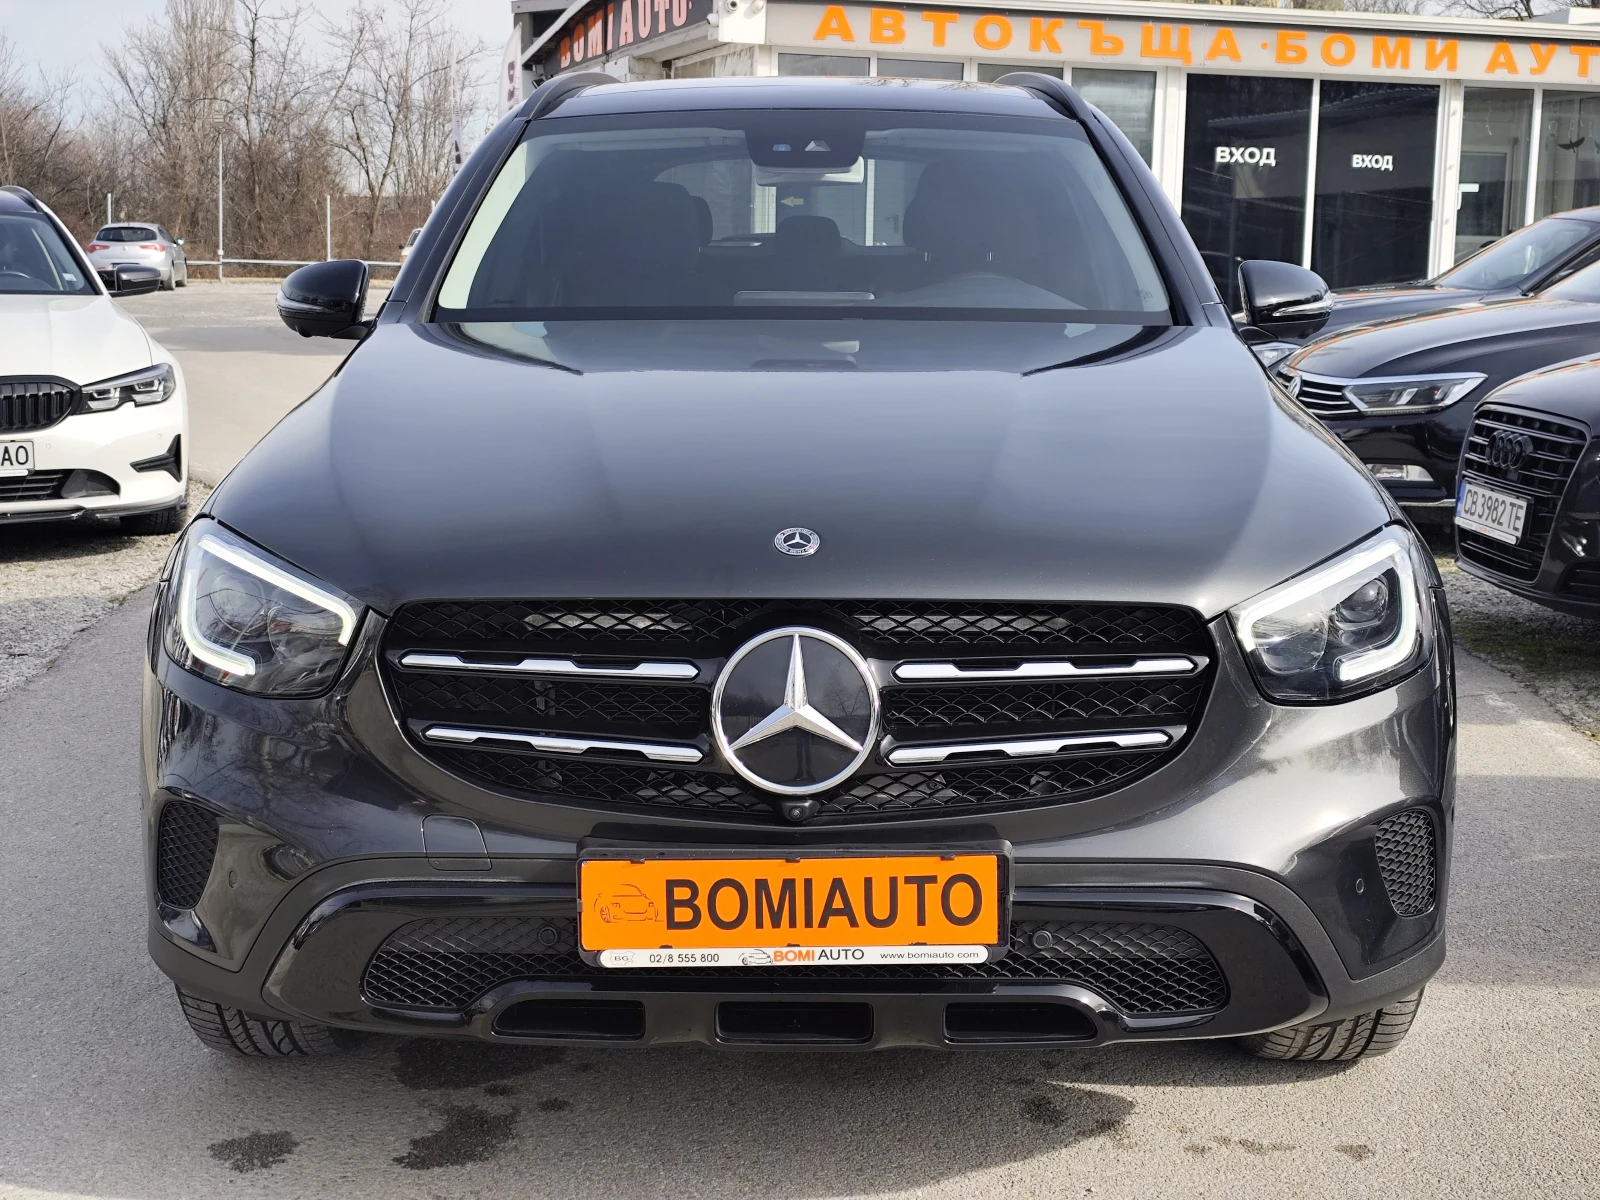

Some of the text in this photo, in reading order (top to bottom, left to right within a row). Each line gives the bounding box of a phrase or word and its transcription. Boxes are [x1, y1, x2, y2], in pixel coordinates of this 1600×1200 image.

[813, 5, 1242, 66] АВТОКЪЩА
[1215, 146, 1276, 166] ВХОД
[1352, 154, 1393, 171] ВХОД
[665, 874, 982, 930] BOMIAUTO
[649, 953, 720, 964] 02/8 555 800
[773, 948, 865, 963] BOMI AUTO
[880, 950, 979, 960] www.bomiauto.com
